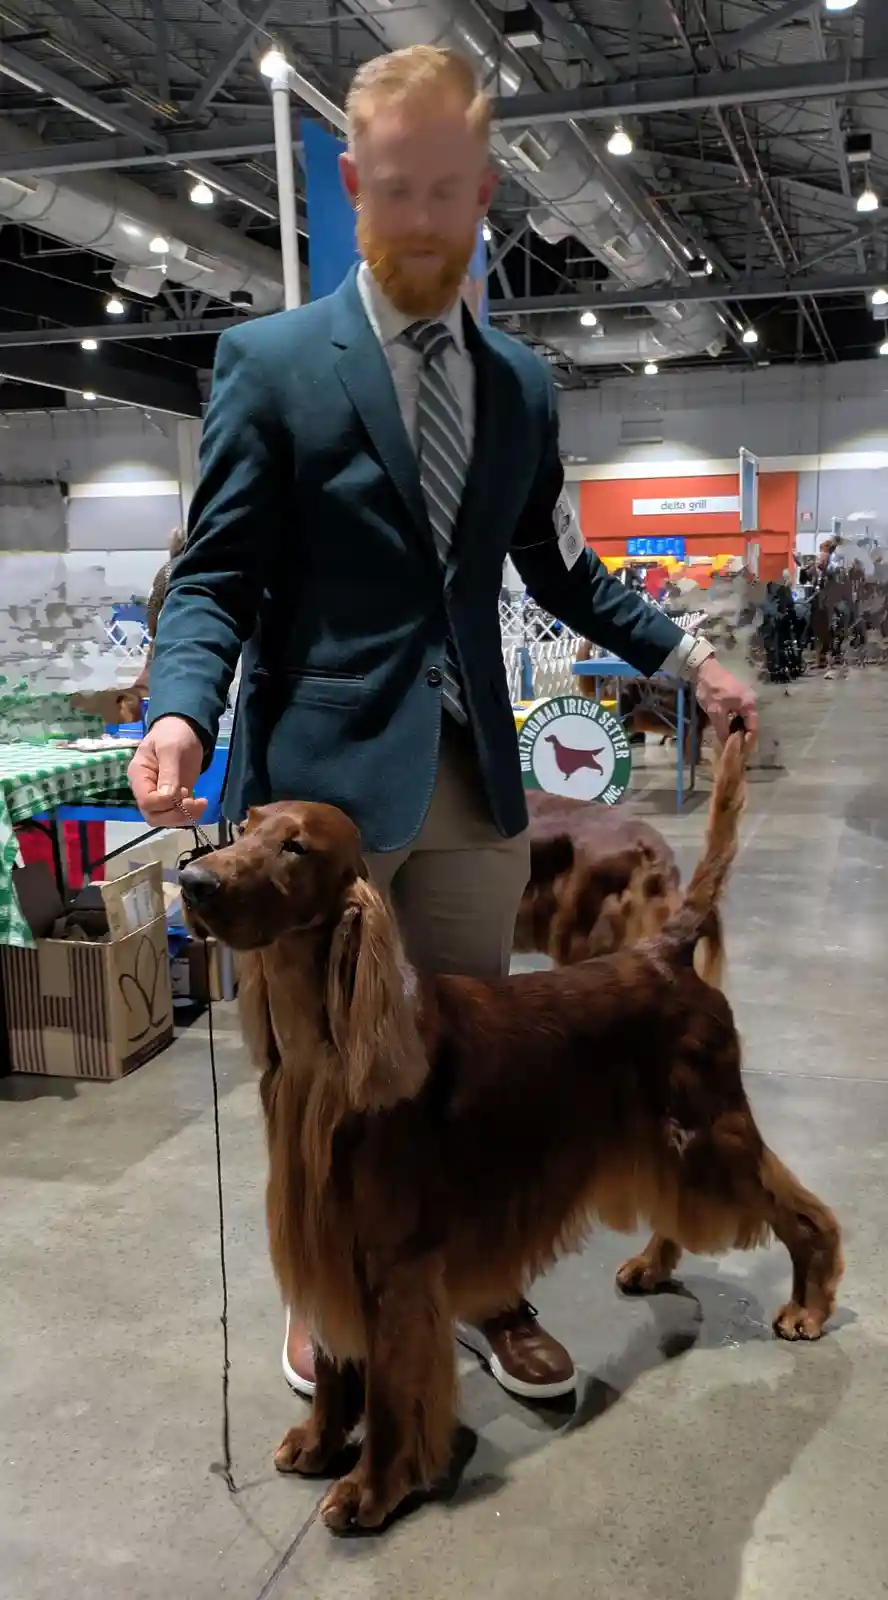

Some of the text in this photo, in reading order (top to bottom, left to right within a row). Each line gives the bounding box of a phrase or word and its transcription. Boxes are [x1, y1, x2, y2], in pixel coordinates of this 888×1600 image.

[660, 500, 707, 511] delta grill
[519, 698, 630, 772] MULTNOMAH IRISH SETTER
[601, 785, 625, 806] INC.
